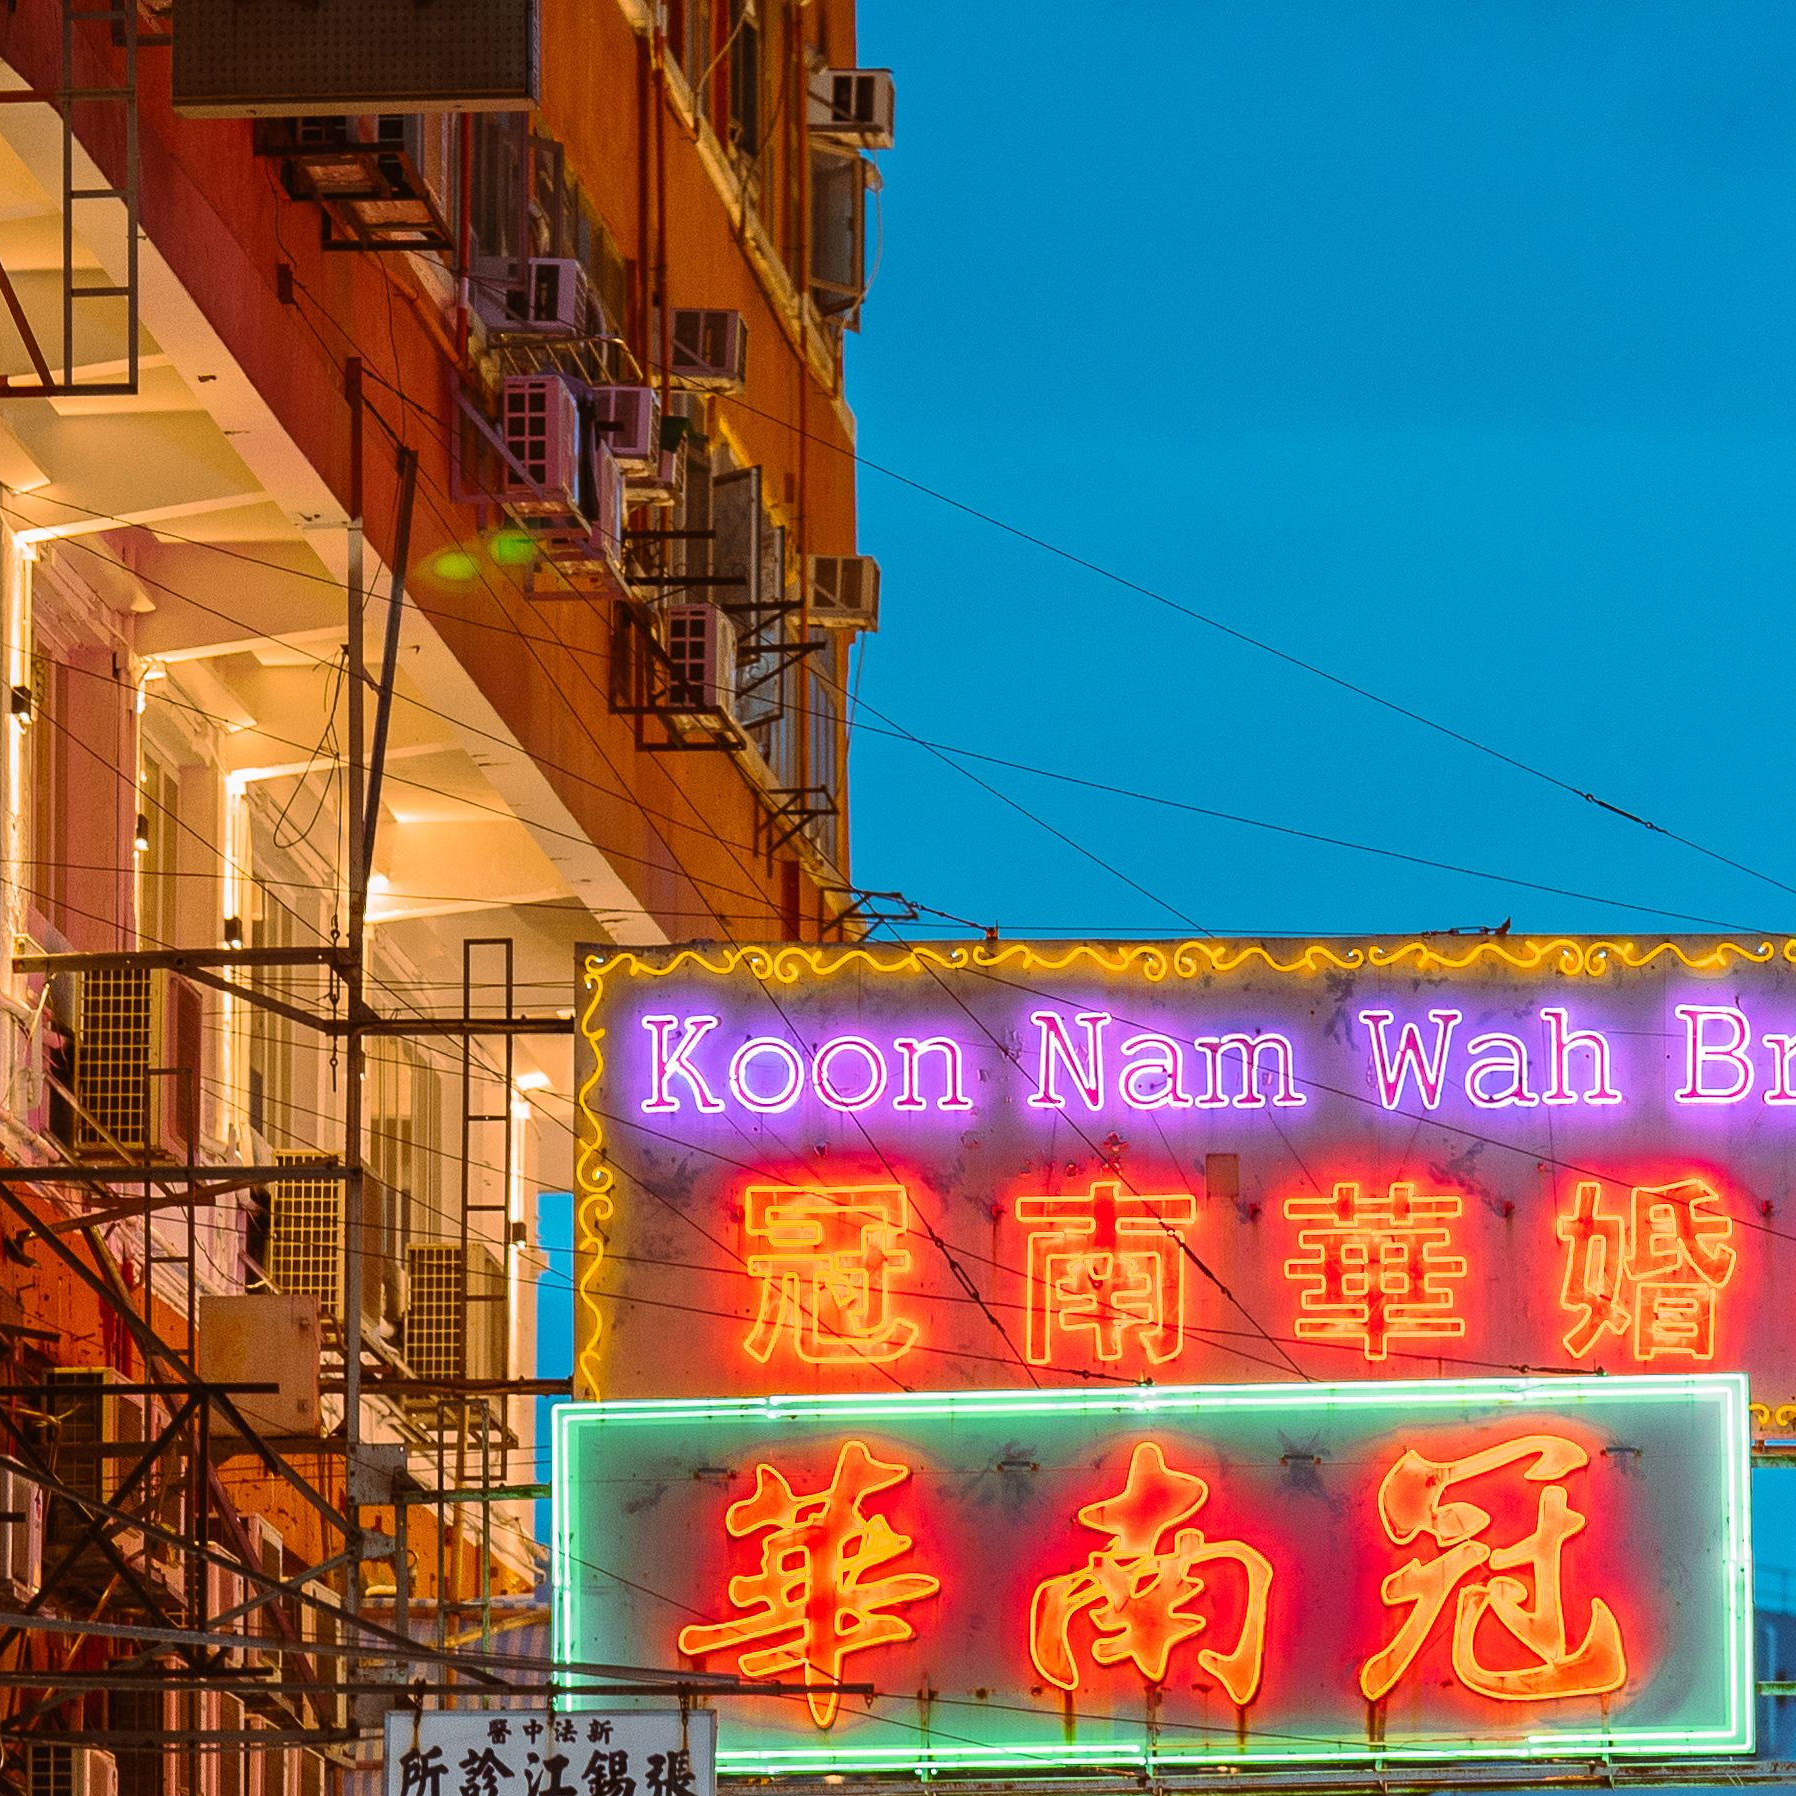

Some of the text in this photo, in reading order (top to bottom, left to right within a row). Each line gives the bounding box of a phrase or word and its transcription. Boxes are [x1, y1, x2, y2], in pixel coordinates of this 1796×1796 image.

[641, 1013, 974, 1115] Koon
[1026, 1010, 1307, 1112] Nam
[1358, 1007, 1623, 1111] Wah
